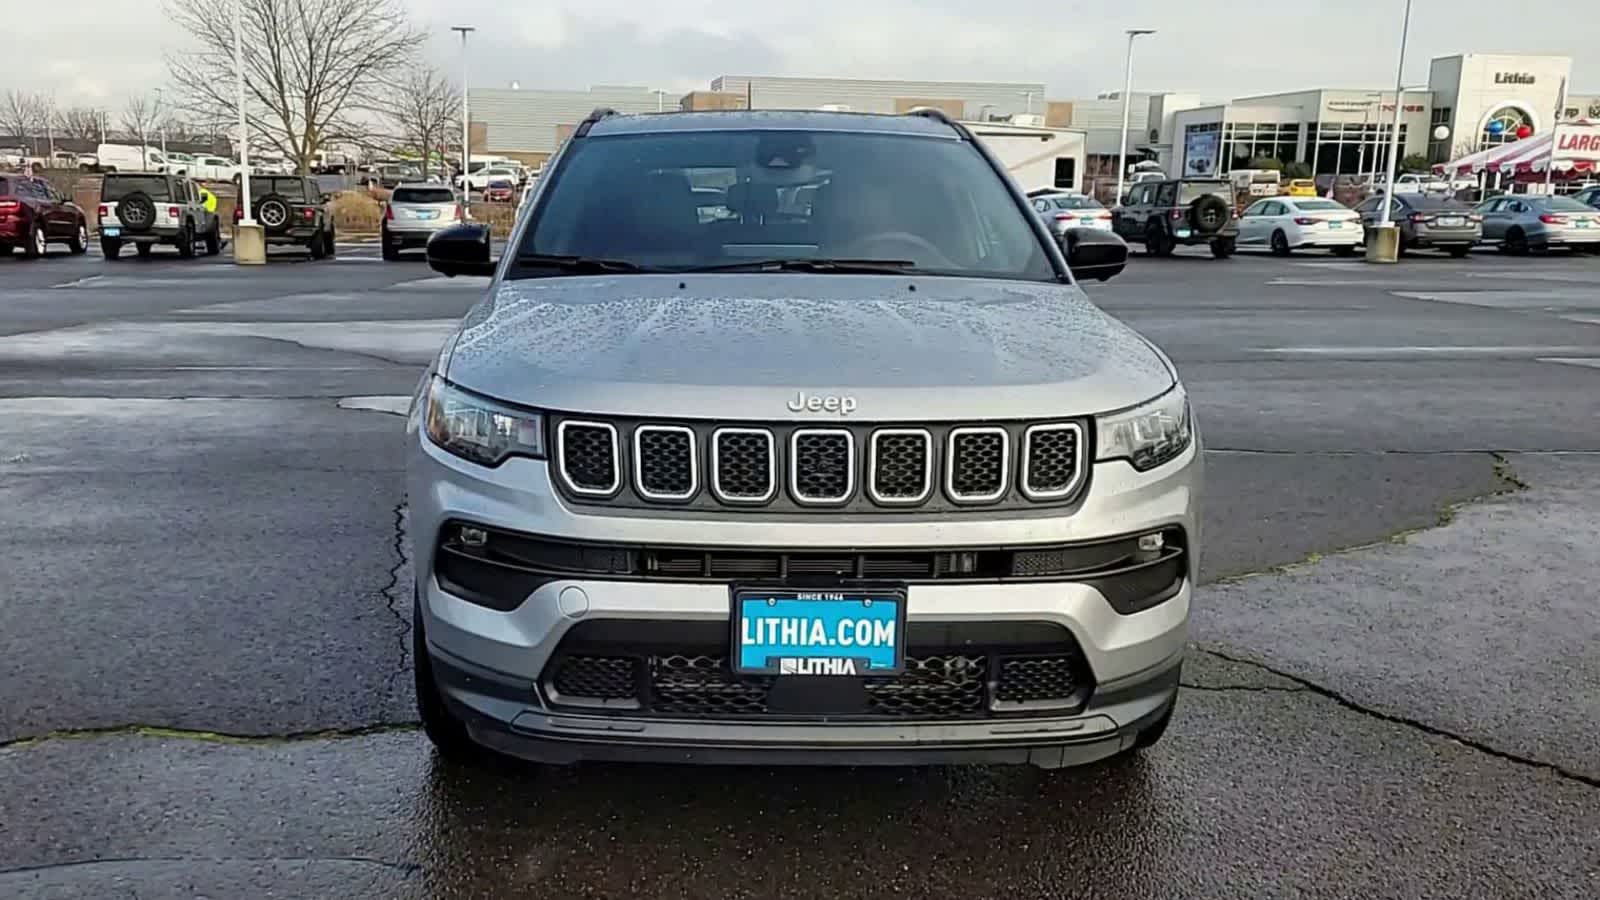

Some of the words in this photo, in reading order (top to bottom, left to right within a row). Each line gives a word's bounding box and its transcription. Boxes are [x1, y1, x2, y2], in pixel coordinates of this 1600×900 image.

[1495, 72, 1535, 84] Lithia
[787, 391, 857, 416] Jeep
[797, 591, 822, 601] SINCE
[741, 616, 895, 647] LITHIA.COM
[797, 657, 857, 675] LITHIA
